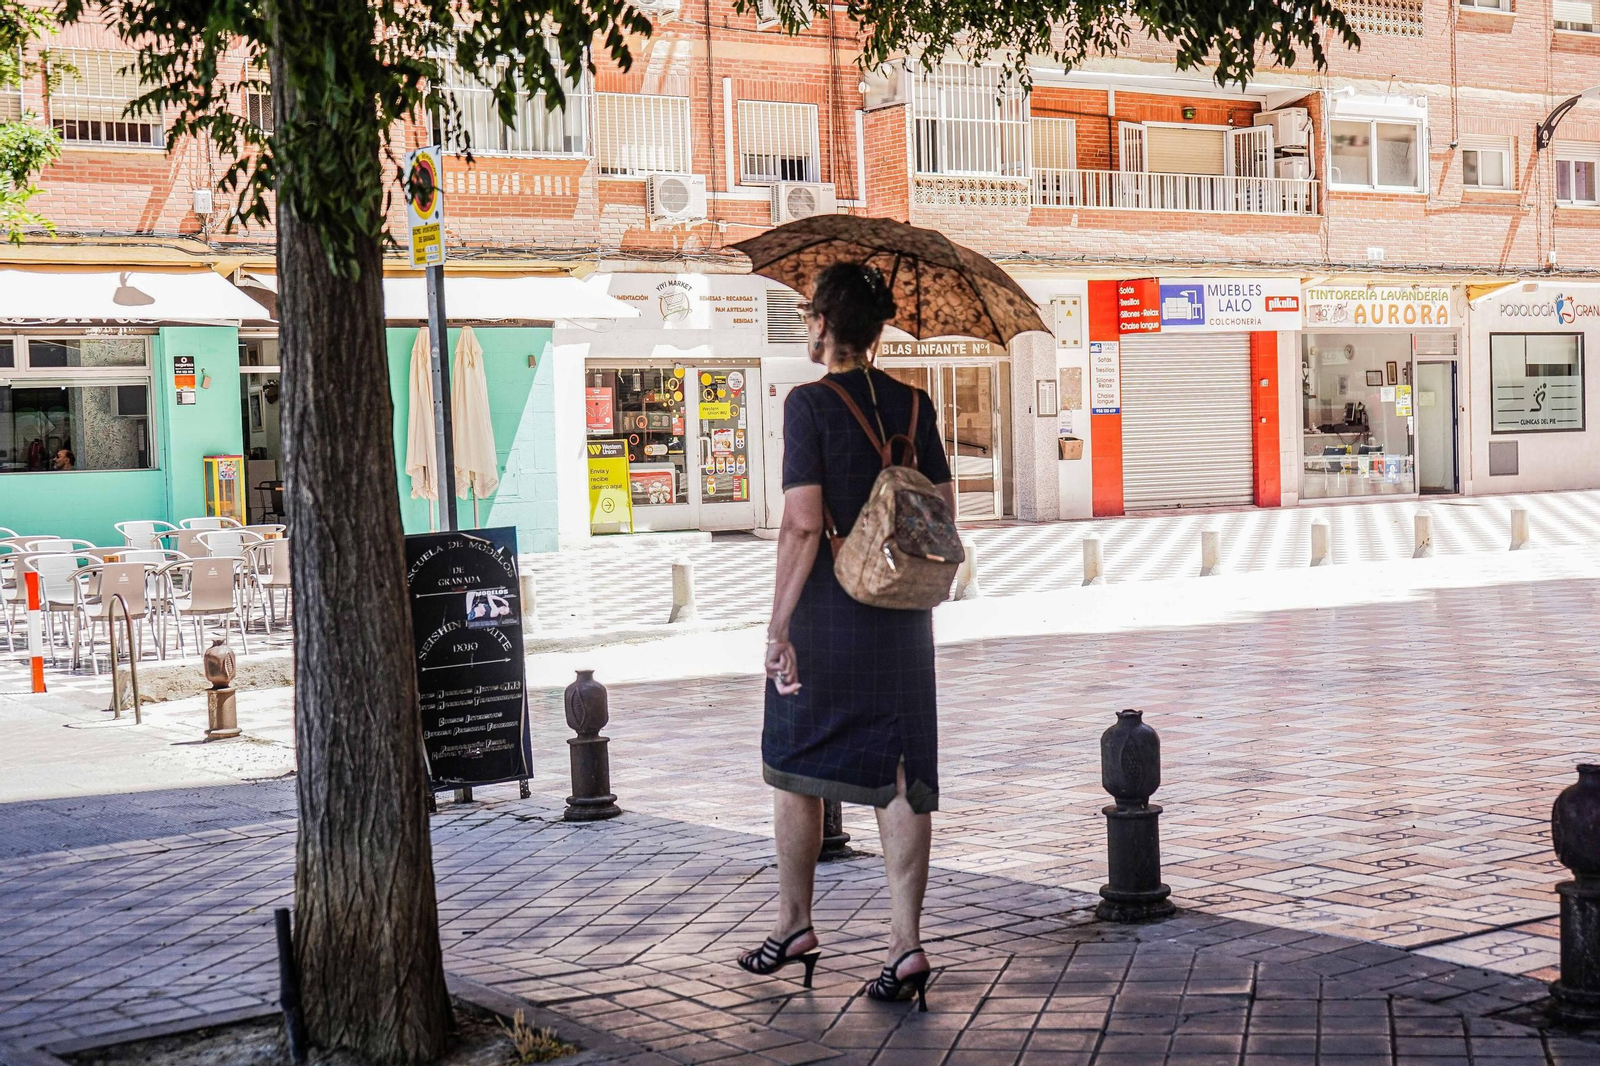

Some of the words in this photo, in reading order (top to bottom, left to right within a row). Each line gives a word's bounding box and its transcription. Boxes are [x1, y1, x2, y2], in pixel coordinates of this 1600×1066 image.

[656, 280, 668, 292] YIYI
[668, 280, 692, 292] MARKET
[1207, 284, 1262, 296] MUEBLES
[1308, 289, 1377, 300] TINTORERÍA
[1381, 288, 1449, 302] LAVANDERÍA
[1218, 298, 1252, 312] LALO
[1500, 302, 1556, 317] PODOLOGÍA
[1354, 304, 1448, 324] AURORA
[1209, 316, 1262, 326] COLCHONERÍA
[881, 344, 912, 355] BLAS
[917, 344, 966, 354] INFANTE
[448, 541, 464, 549] DE
[468, 541, 514, 578] MODELOS
[438, 576, 481, 586] GRANADA
[453, 642, 478, 652] DOJO
